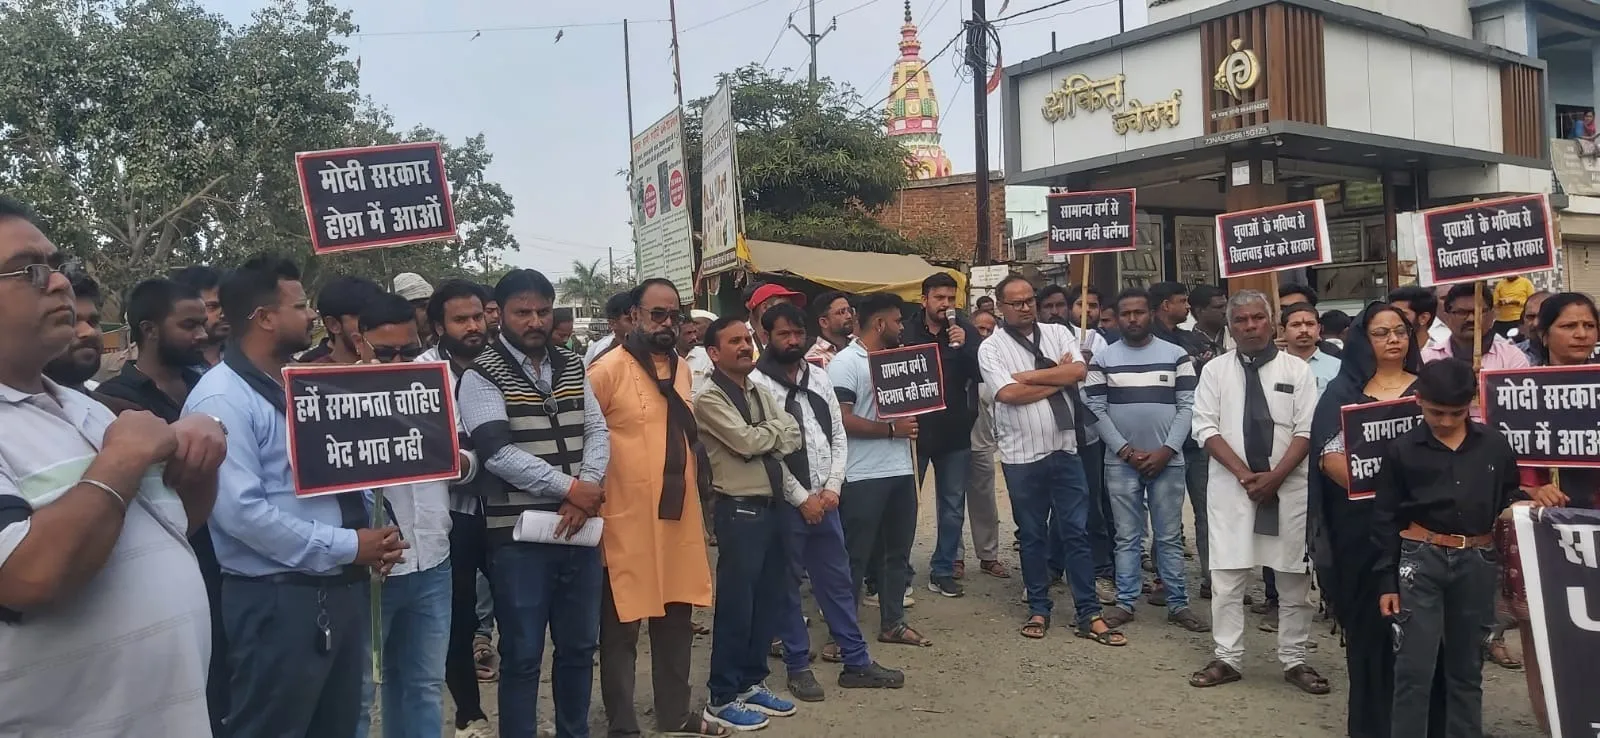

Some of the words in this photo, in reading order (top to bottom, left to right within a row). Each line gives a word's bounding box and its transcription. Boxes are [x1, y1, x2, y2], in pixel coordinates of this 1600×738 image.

[318, 159, 366, 194] मोदी
[368, 160, 432, 189] सरकार
[323, 206, 365, 240] होश
[367, 201, 386, 233] में
[390, 195, 443, 232] आओं
[1060, 204, 1092, 218] सामान्य
[1094, 198, 1109, 216] वर्ग
[1110, 198, 1119, 215] से
[1051, 225, 1082, 242] भेदभाव
[1084, 223, 1100, 240] नही
[1102, 221, 1129, 239] चलेंगा
[1233, 218, 1259, 243] युवाओं
[1262, 217, 1271, 234] के
[1272, 215, 1297, 232] भविष्य
[1297, 211, 1305, 229] से
[1442, 214, 1475, 245] युवाओं
[1477, 212, 1489, 233] के
[1491, 210, 1521, 232] भविष्य
[1522, 206, 1532, 227] से
[1229, 246, 1262, 263] खिलवाड़
[1263, 240, 1275, 258] बंद
[1276, 238, 1289, 256] करे
[1290, 237, 1316, 254] सरकार
[1437, 247, 1478, 268] खिलवाड़
[1480, 240, 1495, 262] बंद
[1496, 238, 1511, 260] करे
[1512, 237, 1544, 257] सरकार
[881, 361, 908, 379] सामान्य
[908, 354, 921, 374] वर्ग
[920, 354, 928, 372] से
[294, 385, 320, 422] हमें
[325, 391, 392, 420] समानता
[393, 382, 440, 416] चाहिए
[877, 387, 904, 406] भेदभाव
[904, 382, 919, 401] नही
[1496, 378, 1538, 410] मोदी
[1542, 383, 1600, 409] सरका
[325, 434, 353, 468] भेद
[358, 437, 389, 465] भाव
[393, 428, 423, 462] नही
[1499, 421, 1531, 454] ोश
[1535, 421, 1551, 455] में
